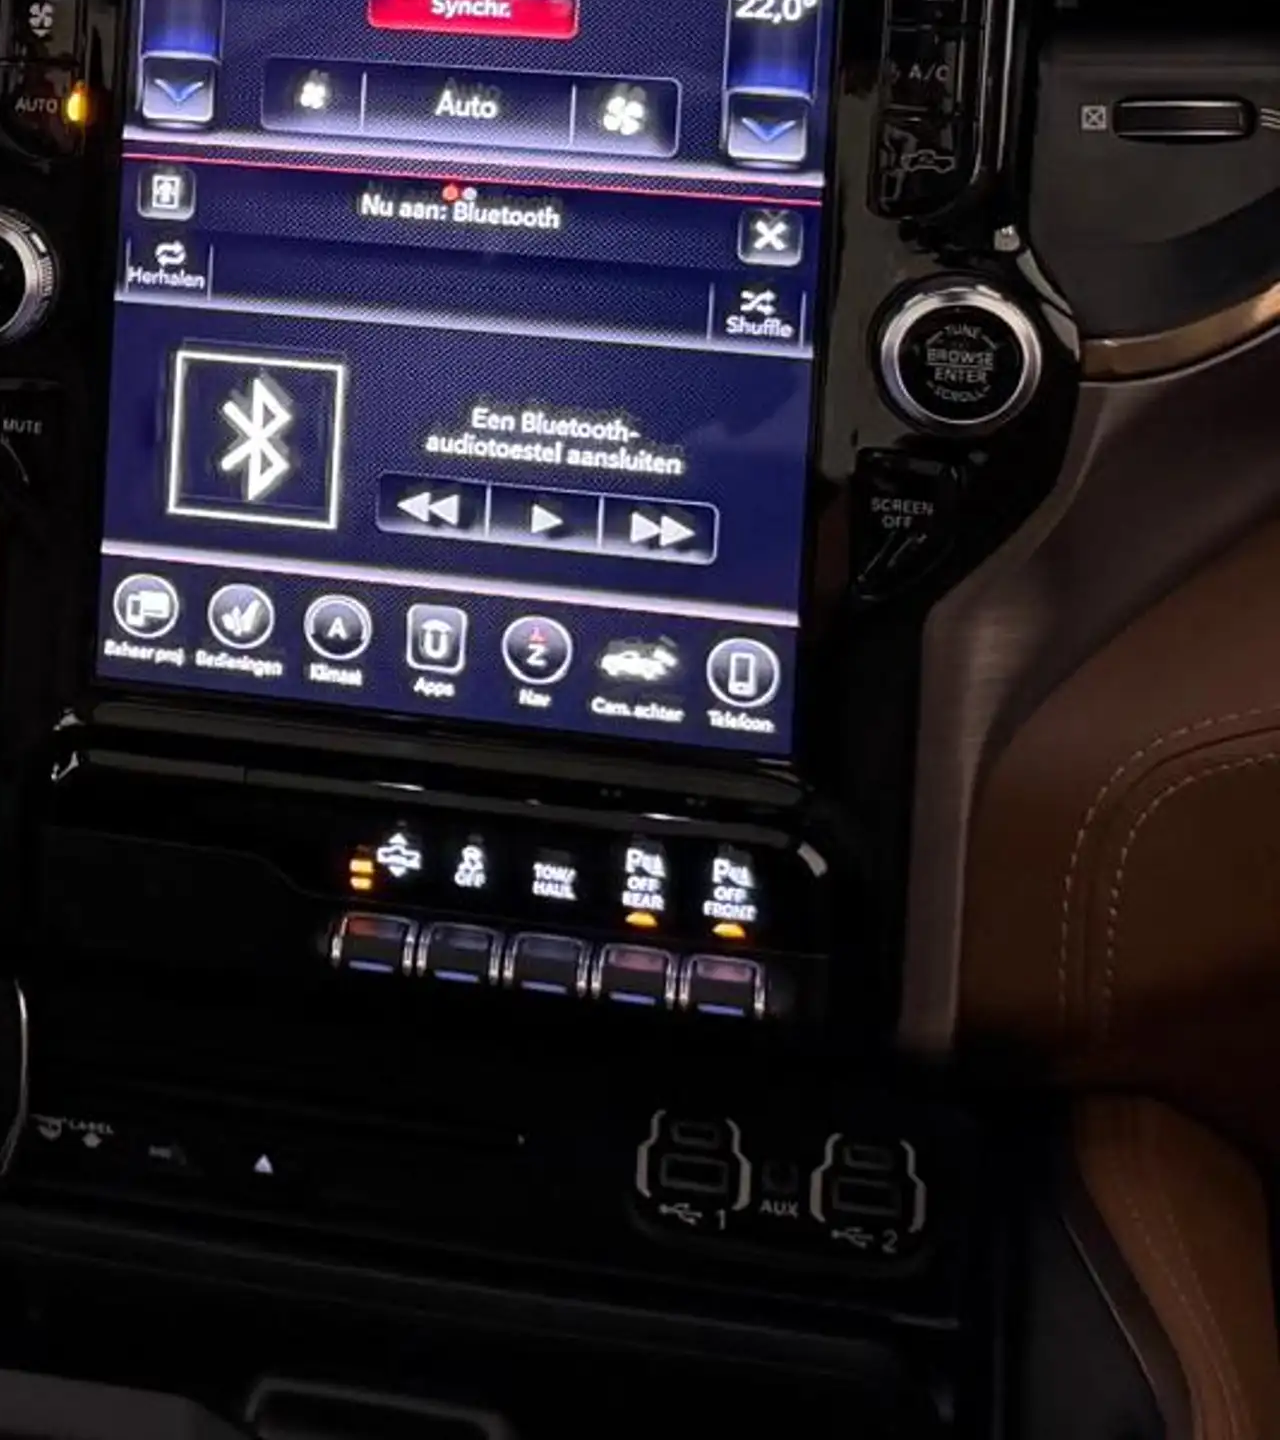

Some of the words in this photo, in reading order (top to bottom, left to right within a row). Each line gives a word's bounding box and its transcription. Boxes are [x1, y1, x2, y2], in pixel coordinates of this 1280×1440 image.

[908, 64, 949, 82] A/C
[14, 97, 58, 115] AUTO
[435, 90, 499, 120] Auto
[360, 193, 394, 218] Nu
[399, 200, 448, 221] aan:
[452, 201, 561, 230] Bluetooth
[127, 265, 205, 289] Herhalen
[725, 315, 795, 339] Shuffle
[926, 346, 994, 366] BROWSE
[934, 367, 988, 383] ENTER
[2, 418, 43, 435] MUTE
[471, 406, 516, 431] Een
[425, 432, 563, 464] audiotoestel
[566, 446, 685, 475] aansluiten
[870, 497, 934, 516] SCREEN
[881, 515, 913, 529] OFF
[412, 676, 456, 699] Apps
[454, 871, 487, 889] OFF
[532, 879, 578, 902] HAUL
[626, 875, 661, 892] OFF
[621, 890, 665, 911] REAR
[712, 884, 748, 902] OFF
[702, 900, 758, 922] FRONT
[759, 1198, 799, 1220] AUX
[881, 1229, 898, 1253] 2
